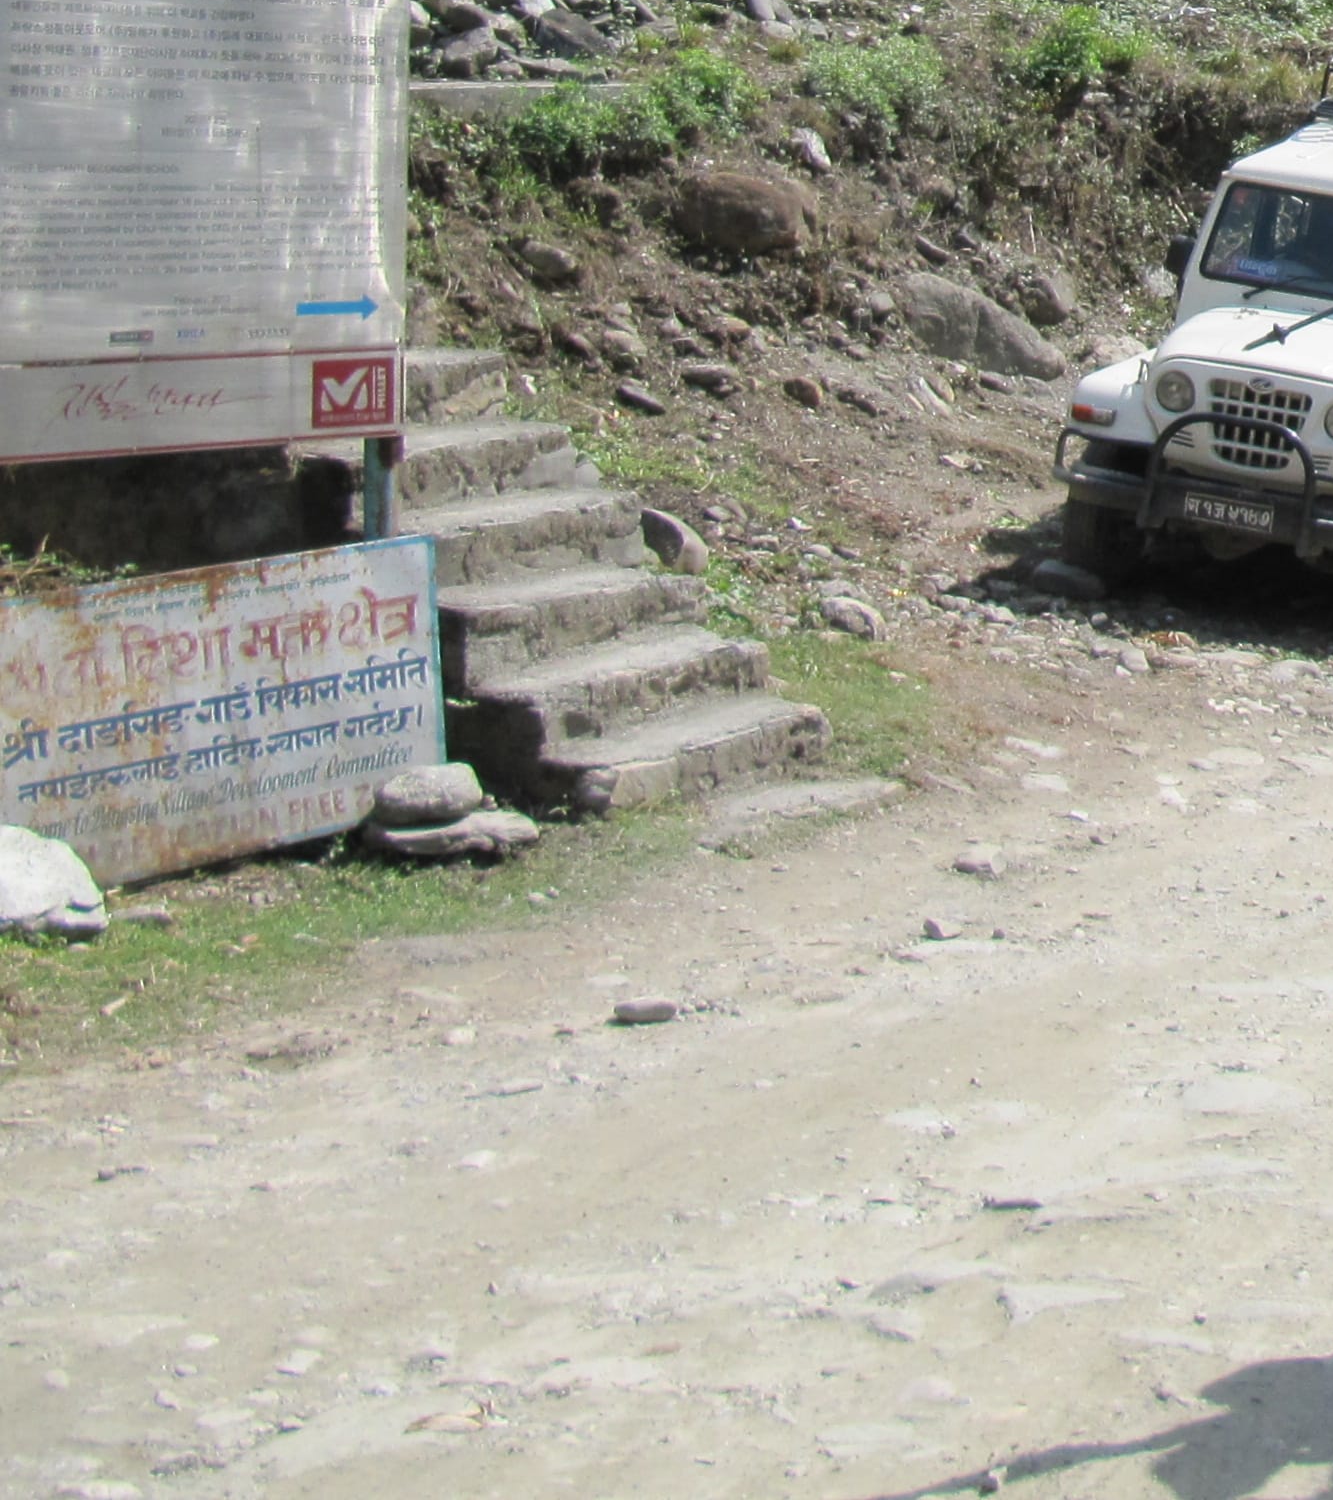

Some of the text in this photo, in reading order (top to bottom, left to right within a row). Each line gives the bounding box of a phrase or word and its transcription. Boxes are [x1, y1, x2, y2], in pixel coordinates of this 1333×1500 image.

[254, 676, 343, 716] विकास
[342, 647, 428, 695] समिति
[265, 720, 341, 755] स्वागत
[220, 758, 321, 804] Development
[324, 741, 413, 780] Committee
